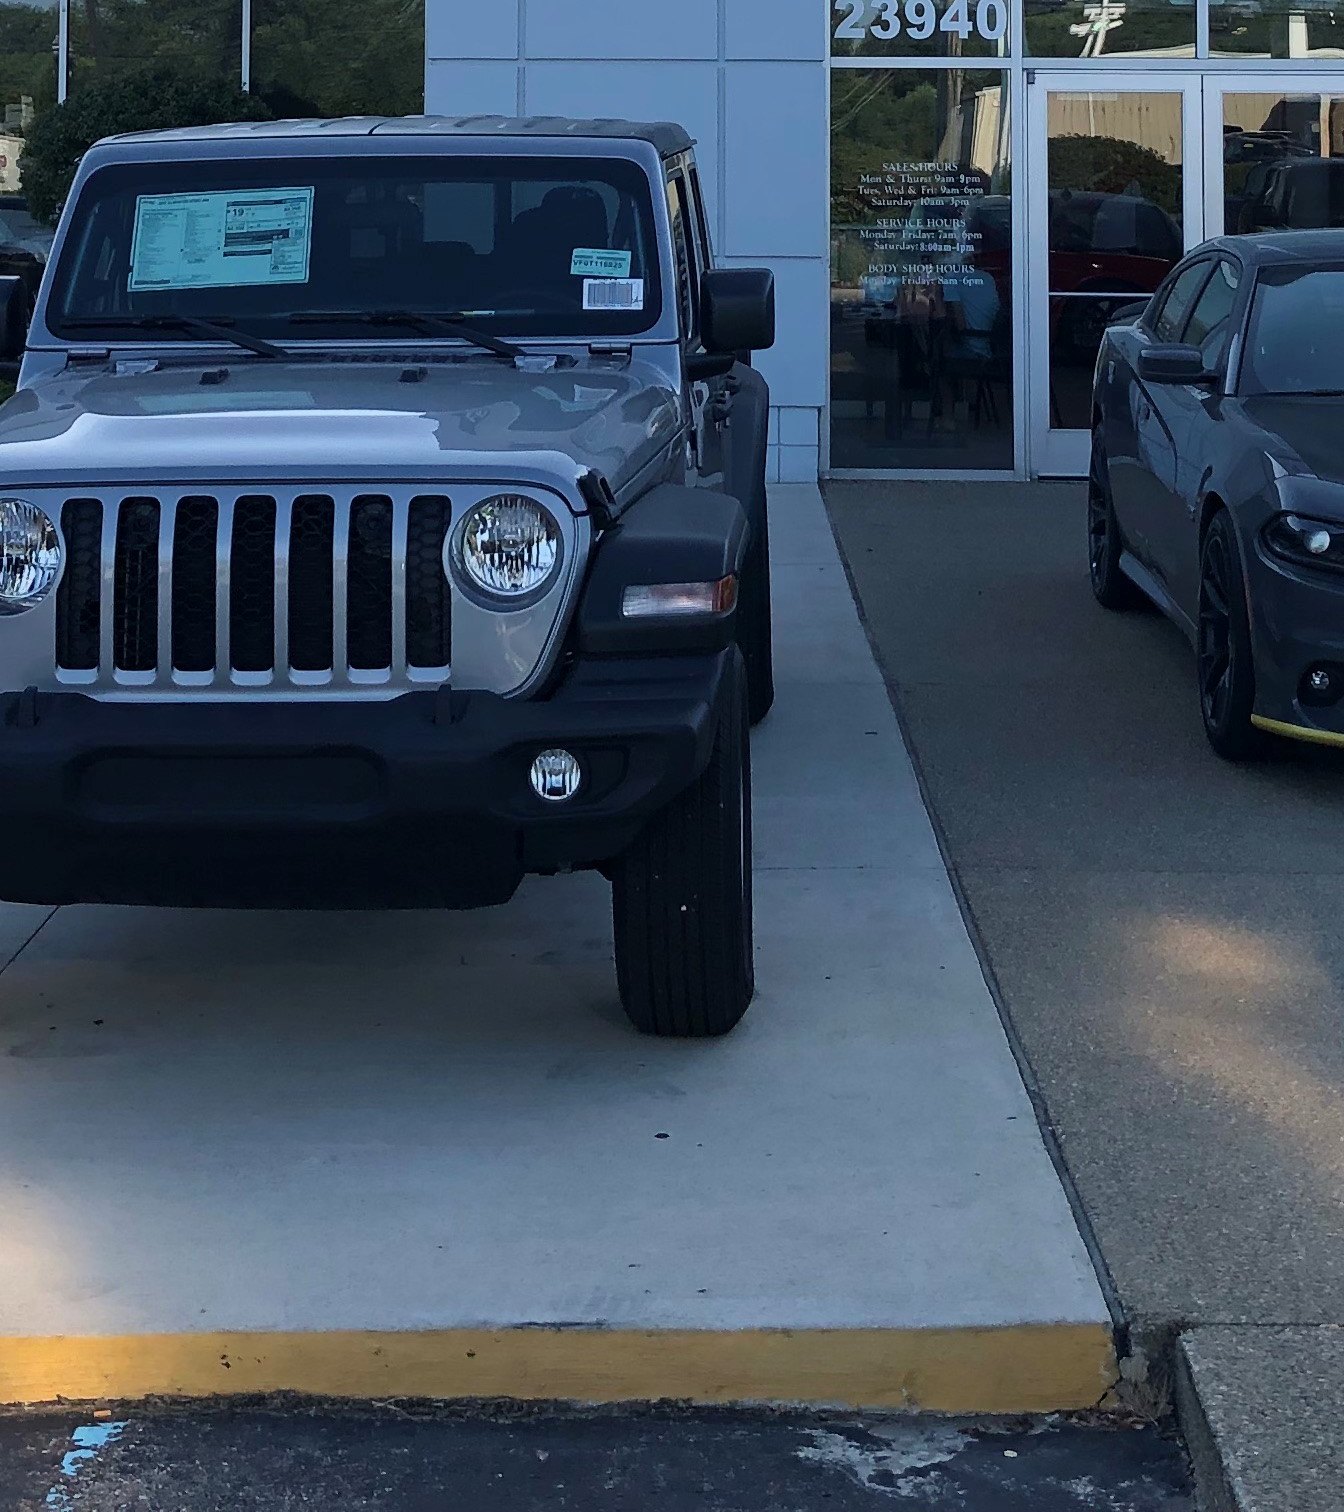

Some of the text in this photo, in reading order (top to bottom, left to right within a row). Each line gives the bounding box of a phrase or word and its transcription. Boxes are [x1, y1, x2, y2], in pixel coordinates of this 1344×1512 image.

[882, 163, 958, 172] SALES HOURS
[885, 185, 904, 195] Wed
[876, 218, 966, 228] SERVICE HOURS
[859, 229, 896, 240] Monday
[868, 264, 975, 274] BODY SHOP HOURS
